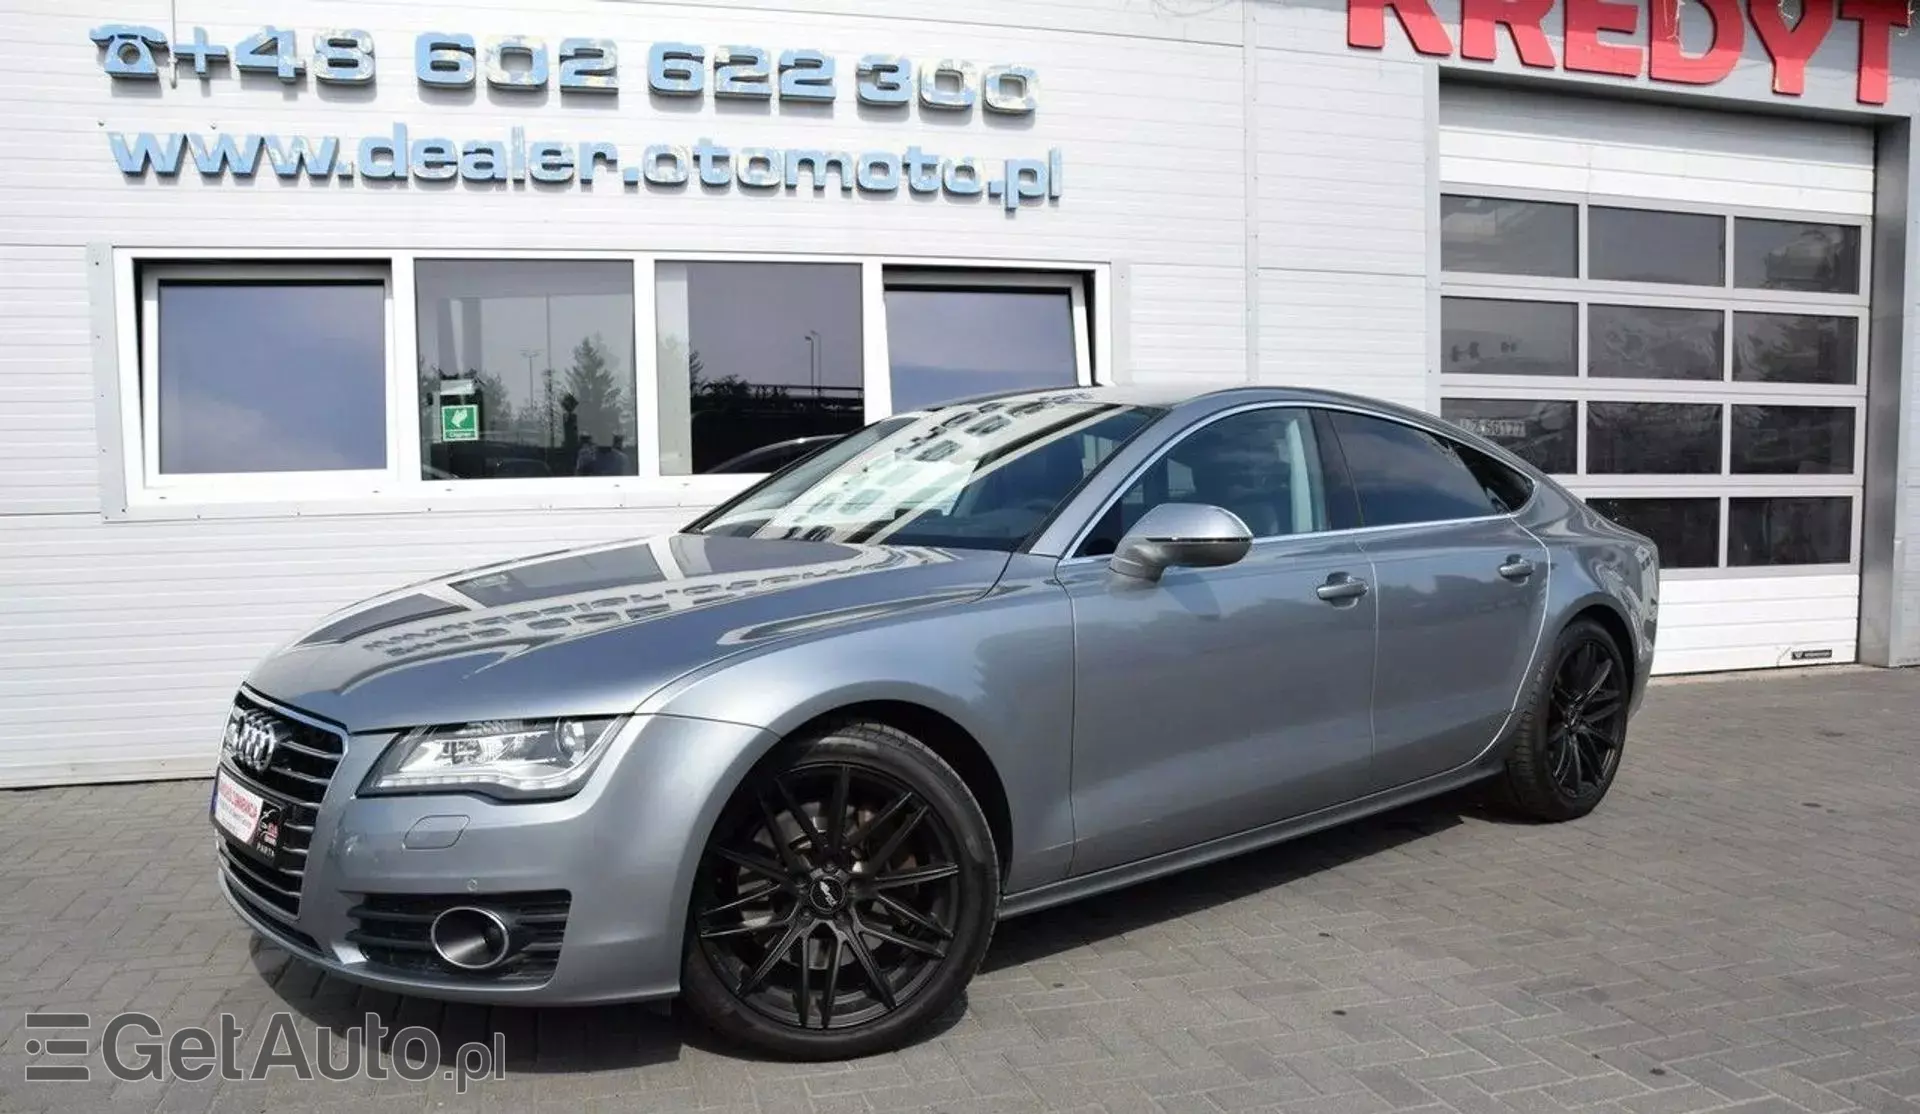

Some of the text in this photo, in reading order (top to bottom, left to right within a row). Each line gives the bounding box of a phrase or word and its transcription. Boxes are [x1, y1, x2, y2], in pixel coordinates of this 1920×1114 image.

[175, 25, 1040, 116] +48 602 622 300
[107, 122, 1063, 212] www.dealer.otomoto.pl
